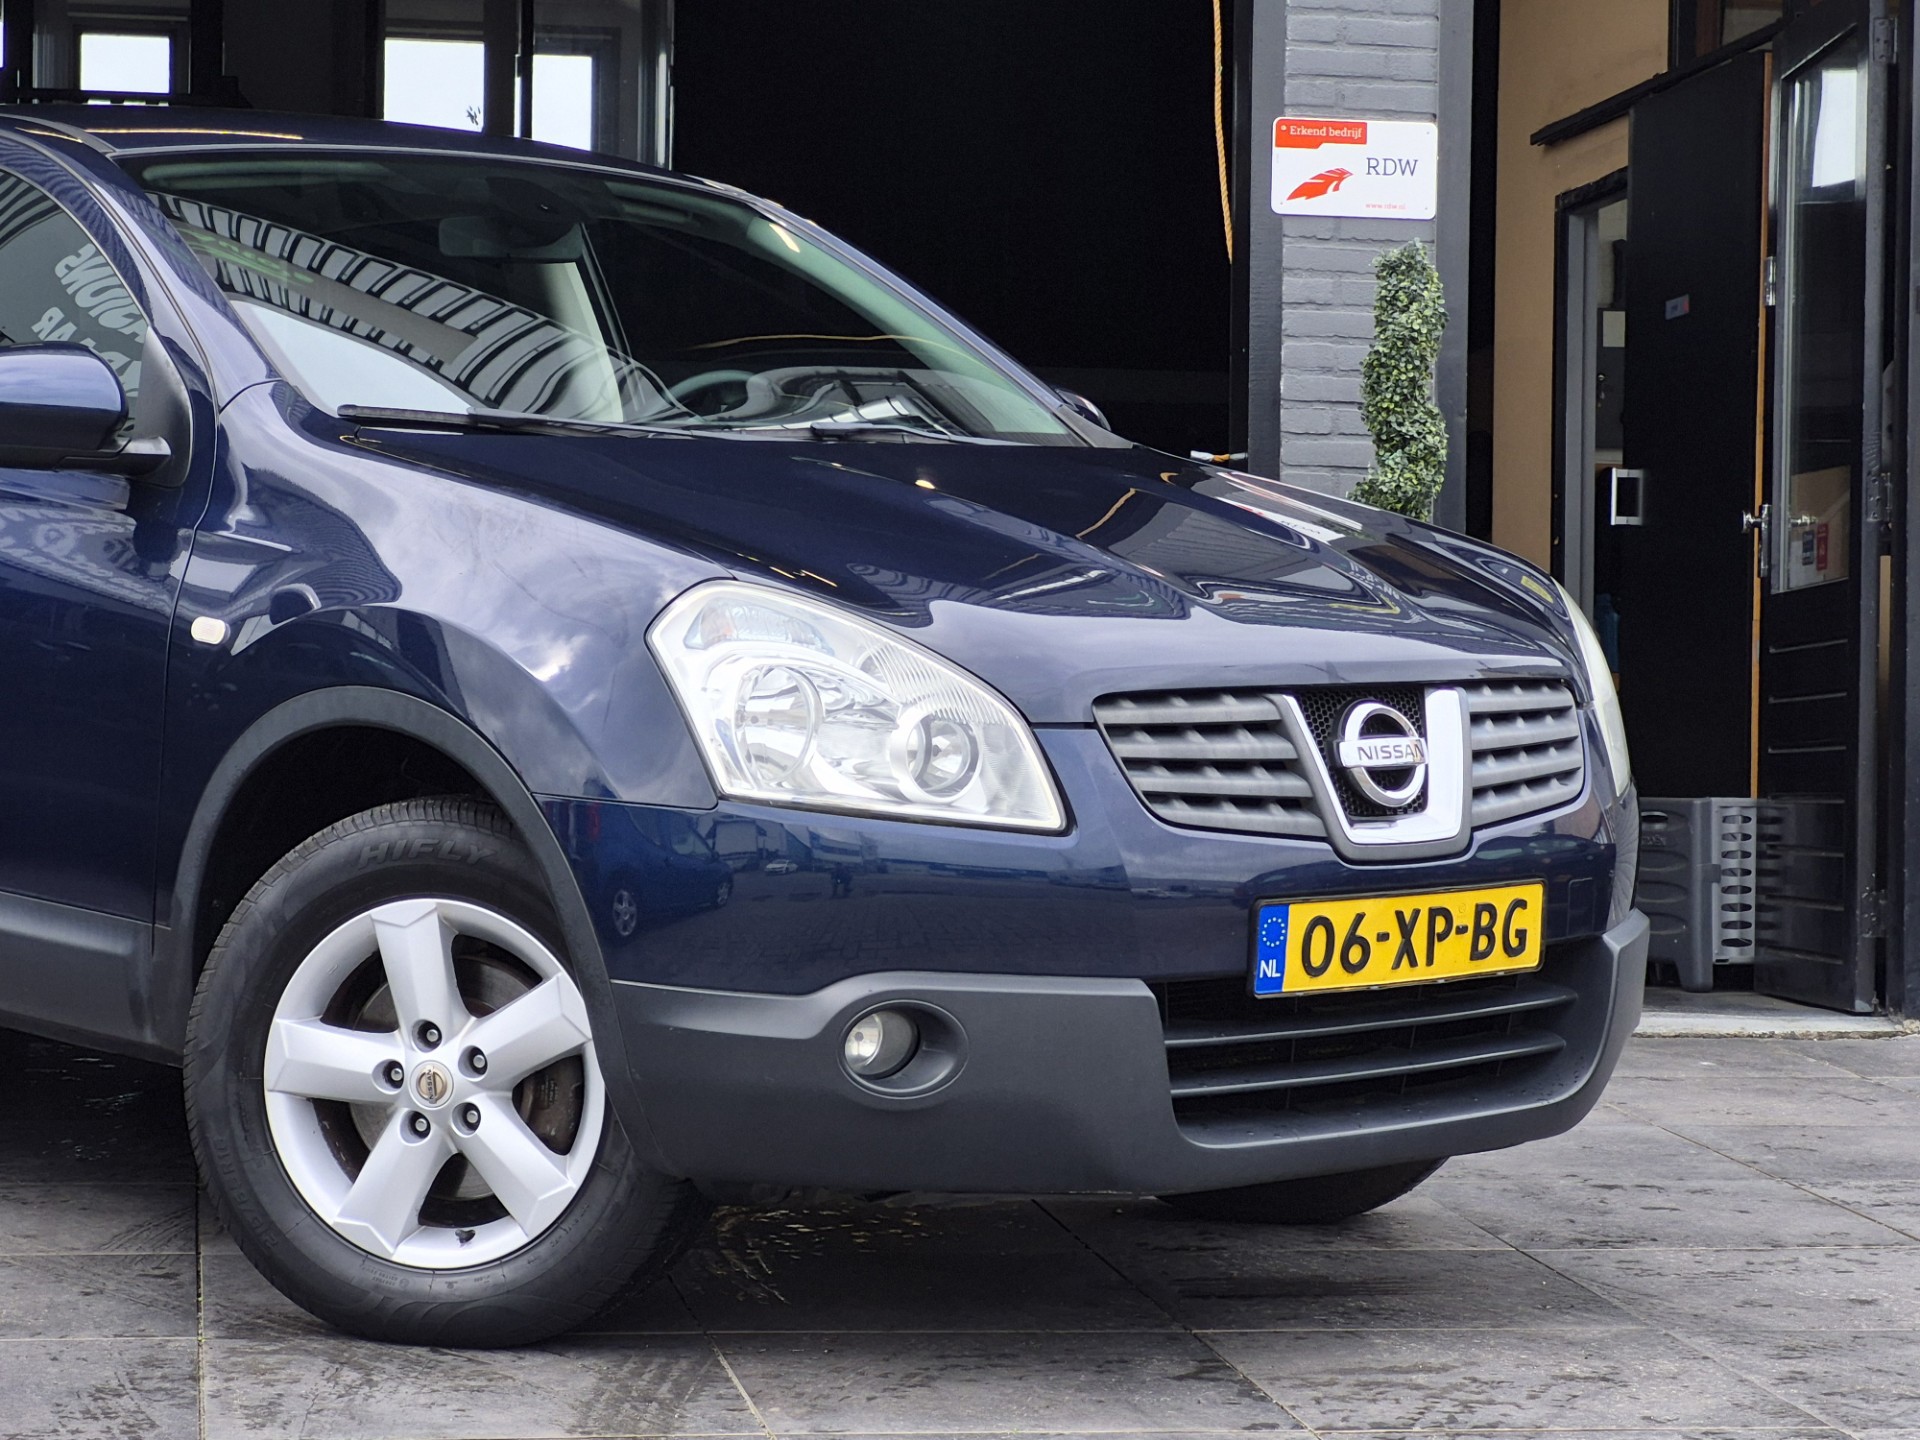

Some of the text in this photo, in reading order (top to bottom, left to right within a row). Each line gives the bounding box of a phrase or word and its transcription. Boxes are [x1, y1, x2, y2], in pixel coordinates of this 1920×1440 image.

[1290, 125, 1362, 139] Erkend bedrijf
[1365, 157, 1418, 176] RDW
[1357, 743, 1425, 761] NISSAN
[358, 839, 496, 870] HIFLY
[1301, 898, 1528, 978] 06-XP-BG
[1259, 959, 1281, 978] NL
